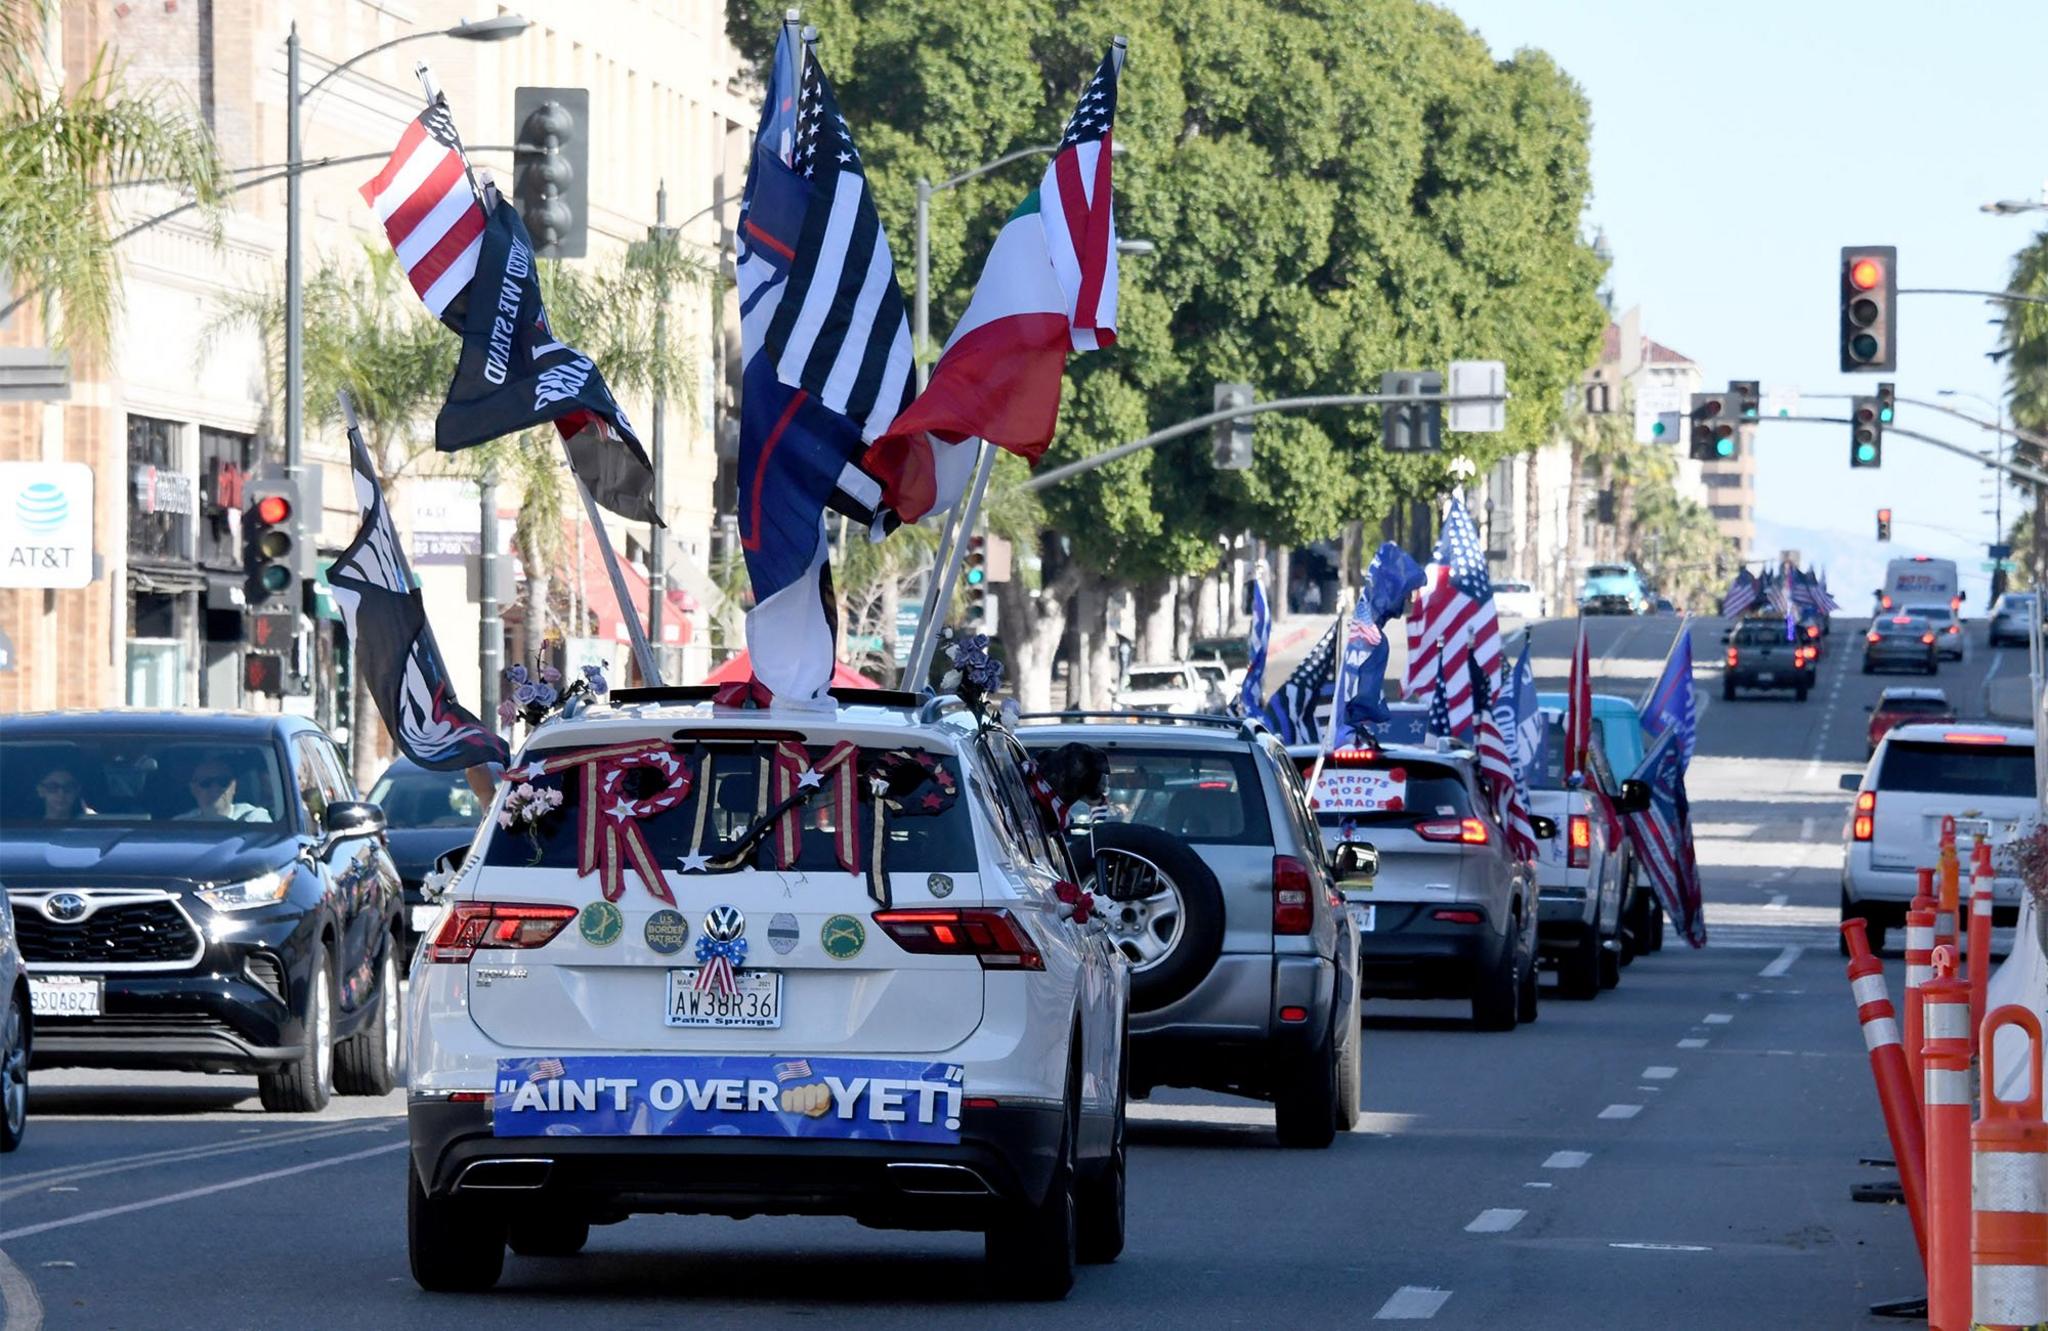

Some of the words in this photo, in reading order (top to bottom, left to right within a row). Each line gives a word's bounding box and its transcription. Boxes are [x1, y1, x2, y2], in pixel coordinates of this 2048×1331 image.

[9, 547, 74, 568] AT&T
[1318, 775, 1389, 789] PATRIOTS
[1330, 787, 1374, 796] ROSE
[1325, 799, 1387, 810] PARADE
[498, 740, 955, 909] TRUMP
[647, 925, 684, 935] BORDER
[648, 935, 683, 944] PATROL
[675, 991, 772, 1018] AW38R36
[672, 1016, 710, 1024] Palm
[715, 1017, 774, 1027] Springs
[648, 1079, 779, 1113] OVER
